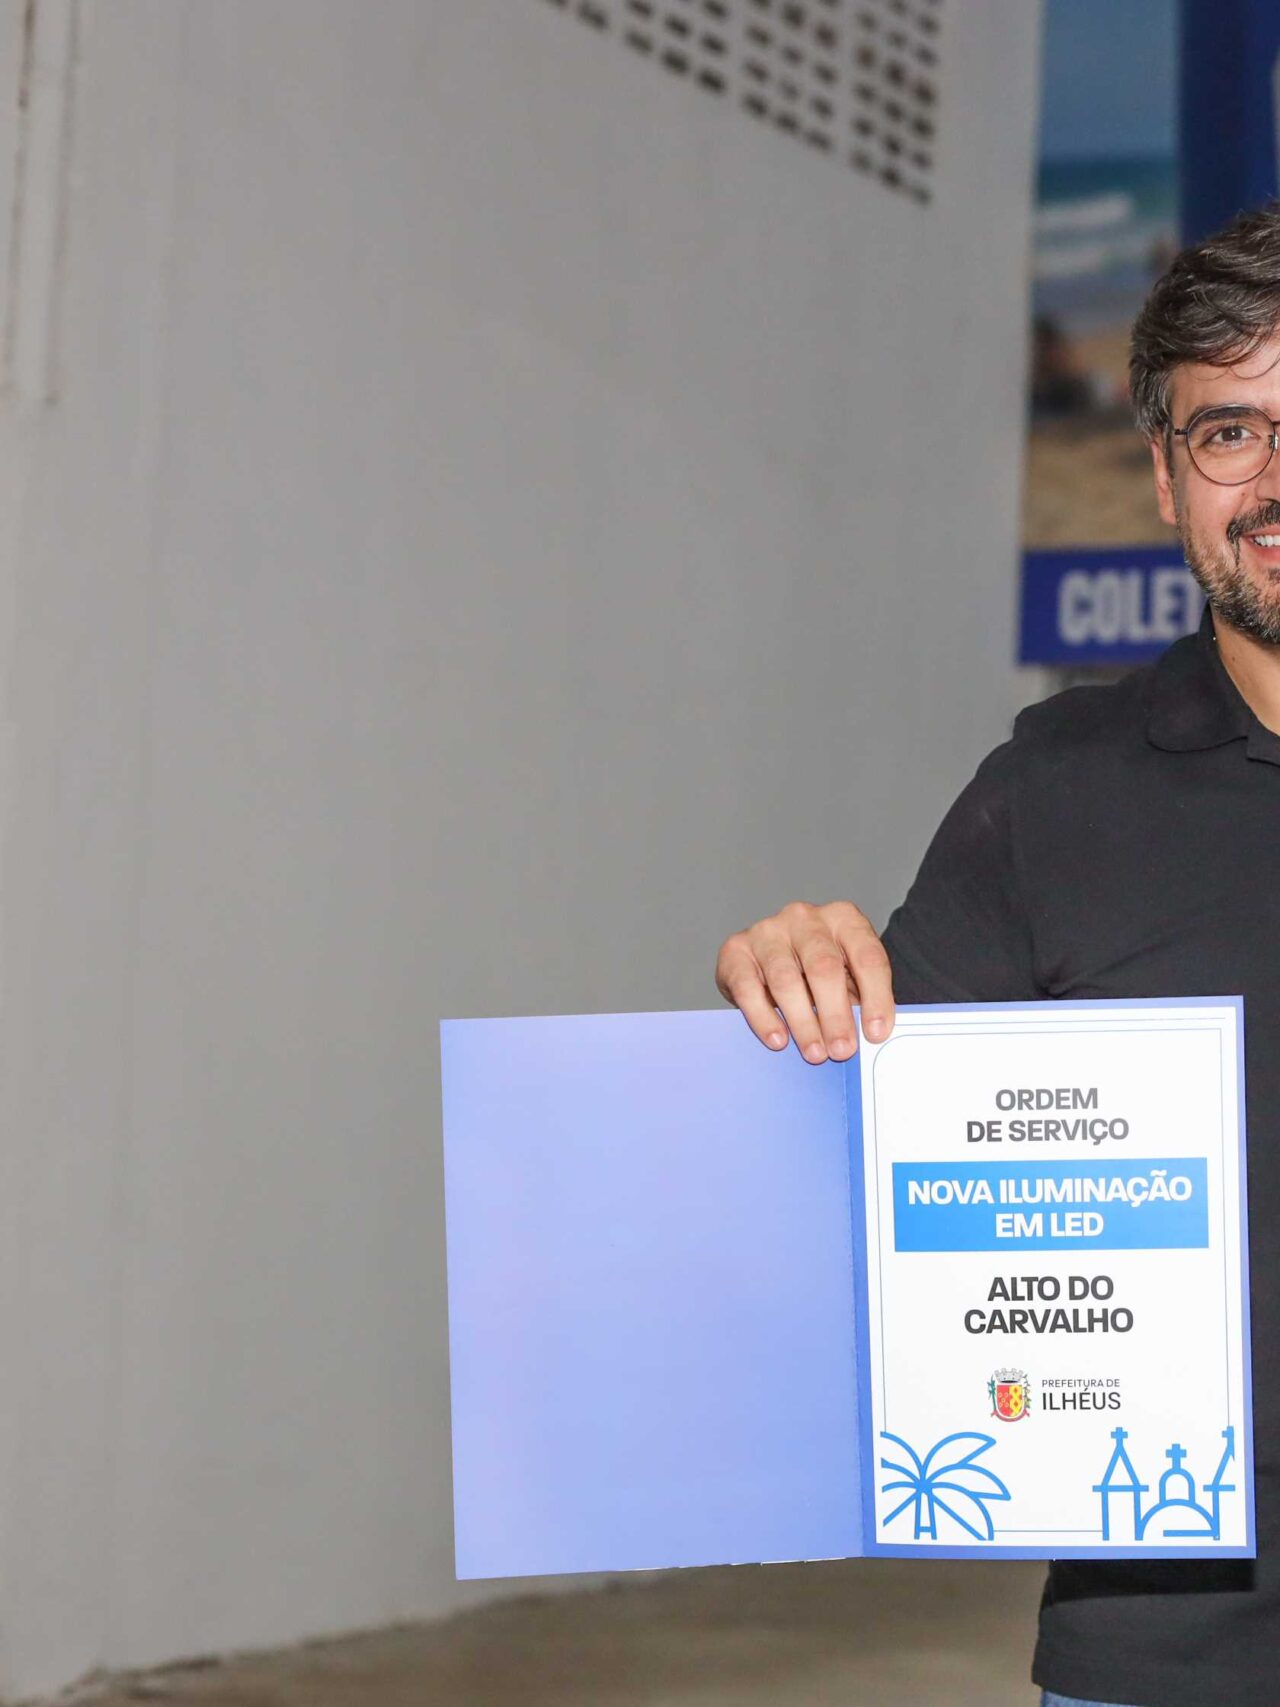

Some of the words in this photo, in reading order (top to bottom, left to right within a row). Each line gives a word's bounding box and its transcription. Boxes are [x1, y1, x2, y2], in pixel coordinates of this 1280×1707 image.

[1058, 568, 1206, 645] COLET
[995, 1087, 1099, 1111] ORDEM
[966, 1120, 1003, 1143] DE
[1008, 1117, 1130, 1146] SERVIÇO
[907, 1180, 995, 1205] NOVA
[999, 1169, 1193, 1208] ILUMINAÇÃO
[995, 1213, 1043, 1238] EM
[1050, 1211, 1104, 1237] LED
[987, 1275, 1061, 1302] ALTO
[1068, 1275, 1114, 1301] DO
[964, 1307, 1134, 1335] CARVALHO
[1042, 1378, 1104, 1388] PREFEITURA
[1106, 1378, 1120, 1388] DE
[1042, 1388, 1121, 1411] ILHÉUS
